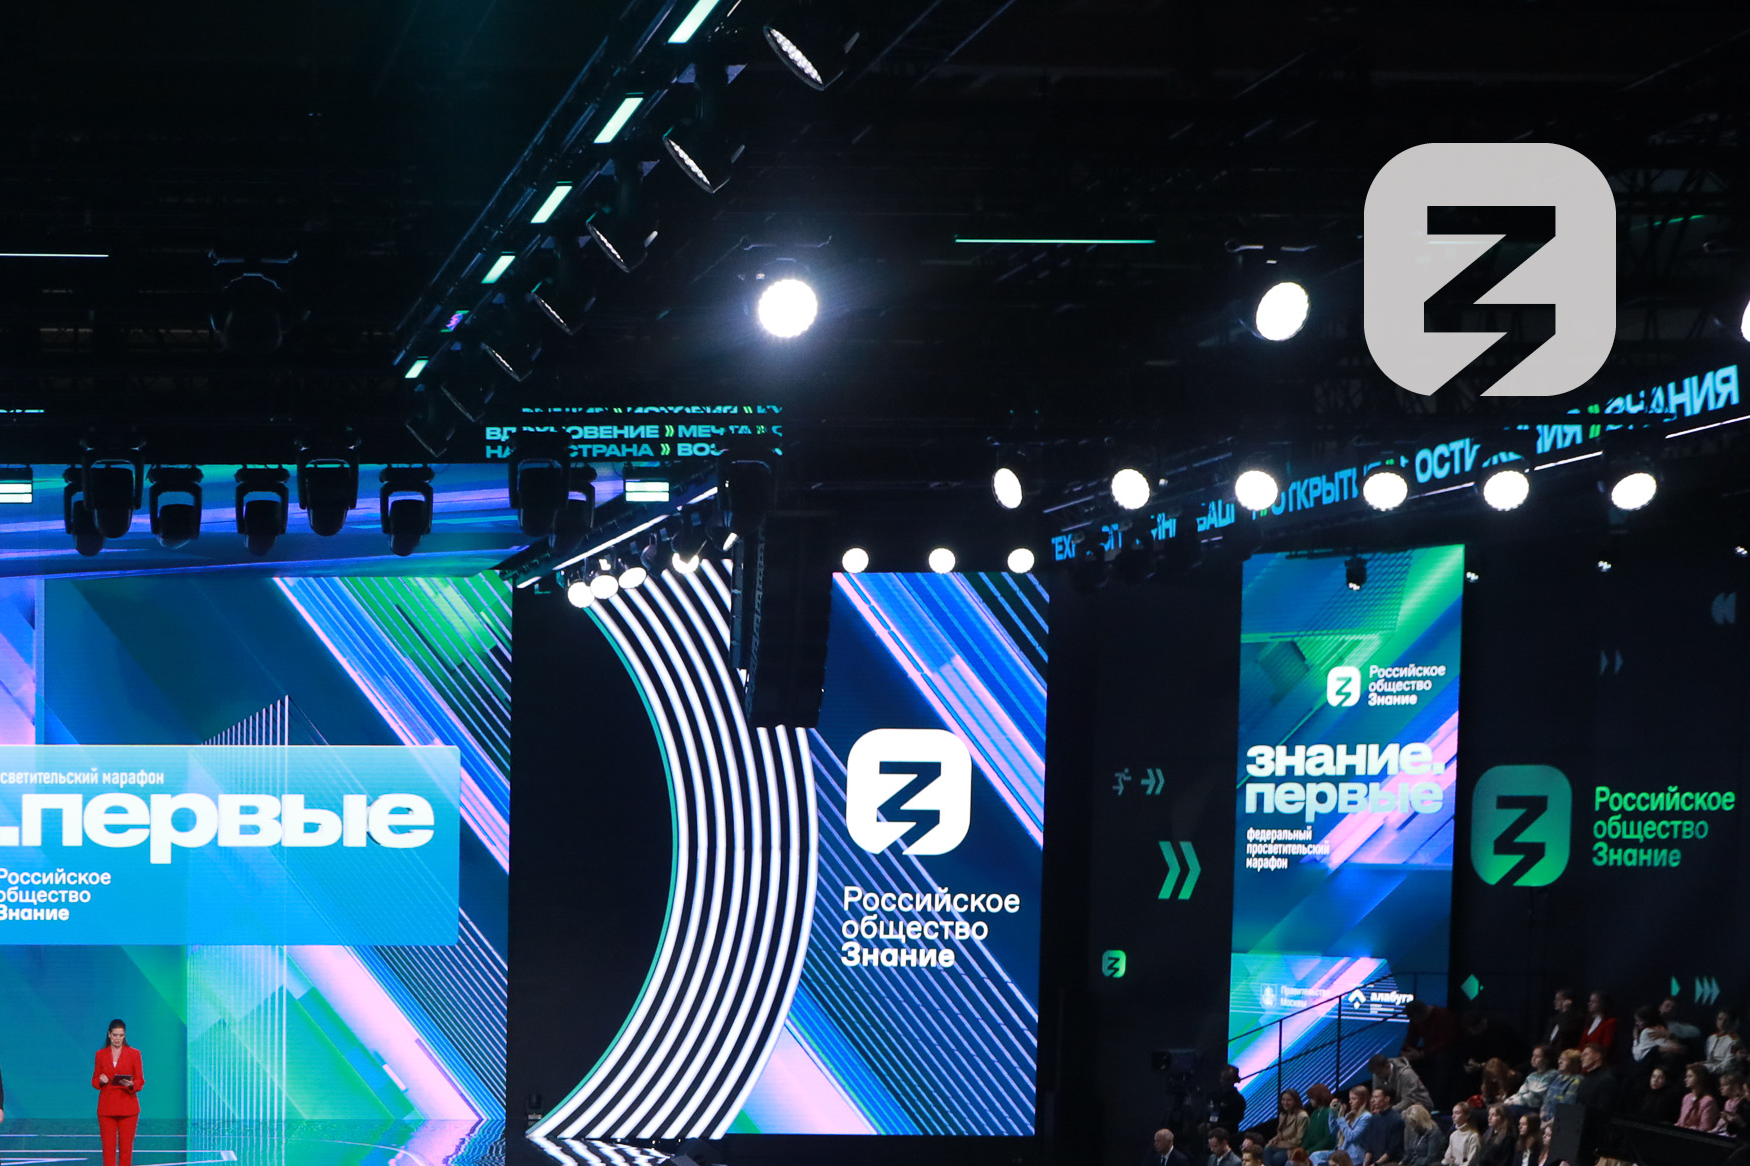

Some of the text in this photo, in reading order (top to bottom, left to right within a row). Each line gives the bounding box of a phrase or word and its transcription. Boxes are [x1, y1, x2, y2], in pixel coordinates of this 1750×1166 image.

[1369, 663, 1446, 679] Российское
[1368, 679, 1432, 694] общество
[1367, 692, 1418, 707] Знание
[1246, 742, 1446, 777] знание.
[103, 769, 165, 788] марафон
[1245, 781, 1445, 823] первые
[1594, 785, 1736, 812] Российское
[1246, 825, 1313, 844] федеральный
[1592, 814, 1709, 843] общество
[1246, 841, 1330, 858] просветительский
[1592, 841, 1682, 868] Знание
[1245, 855, 1288, 872] марафон
[842, 885, 1021, 913] Российское
[841, 914, 989, 943] общество
[841, 941, 956, 968] Знание
[1370, 991, 1414, 1005] алабуга
